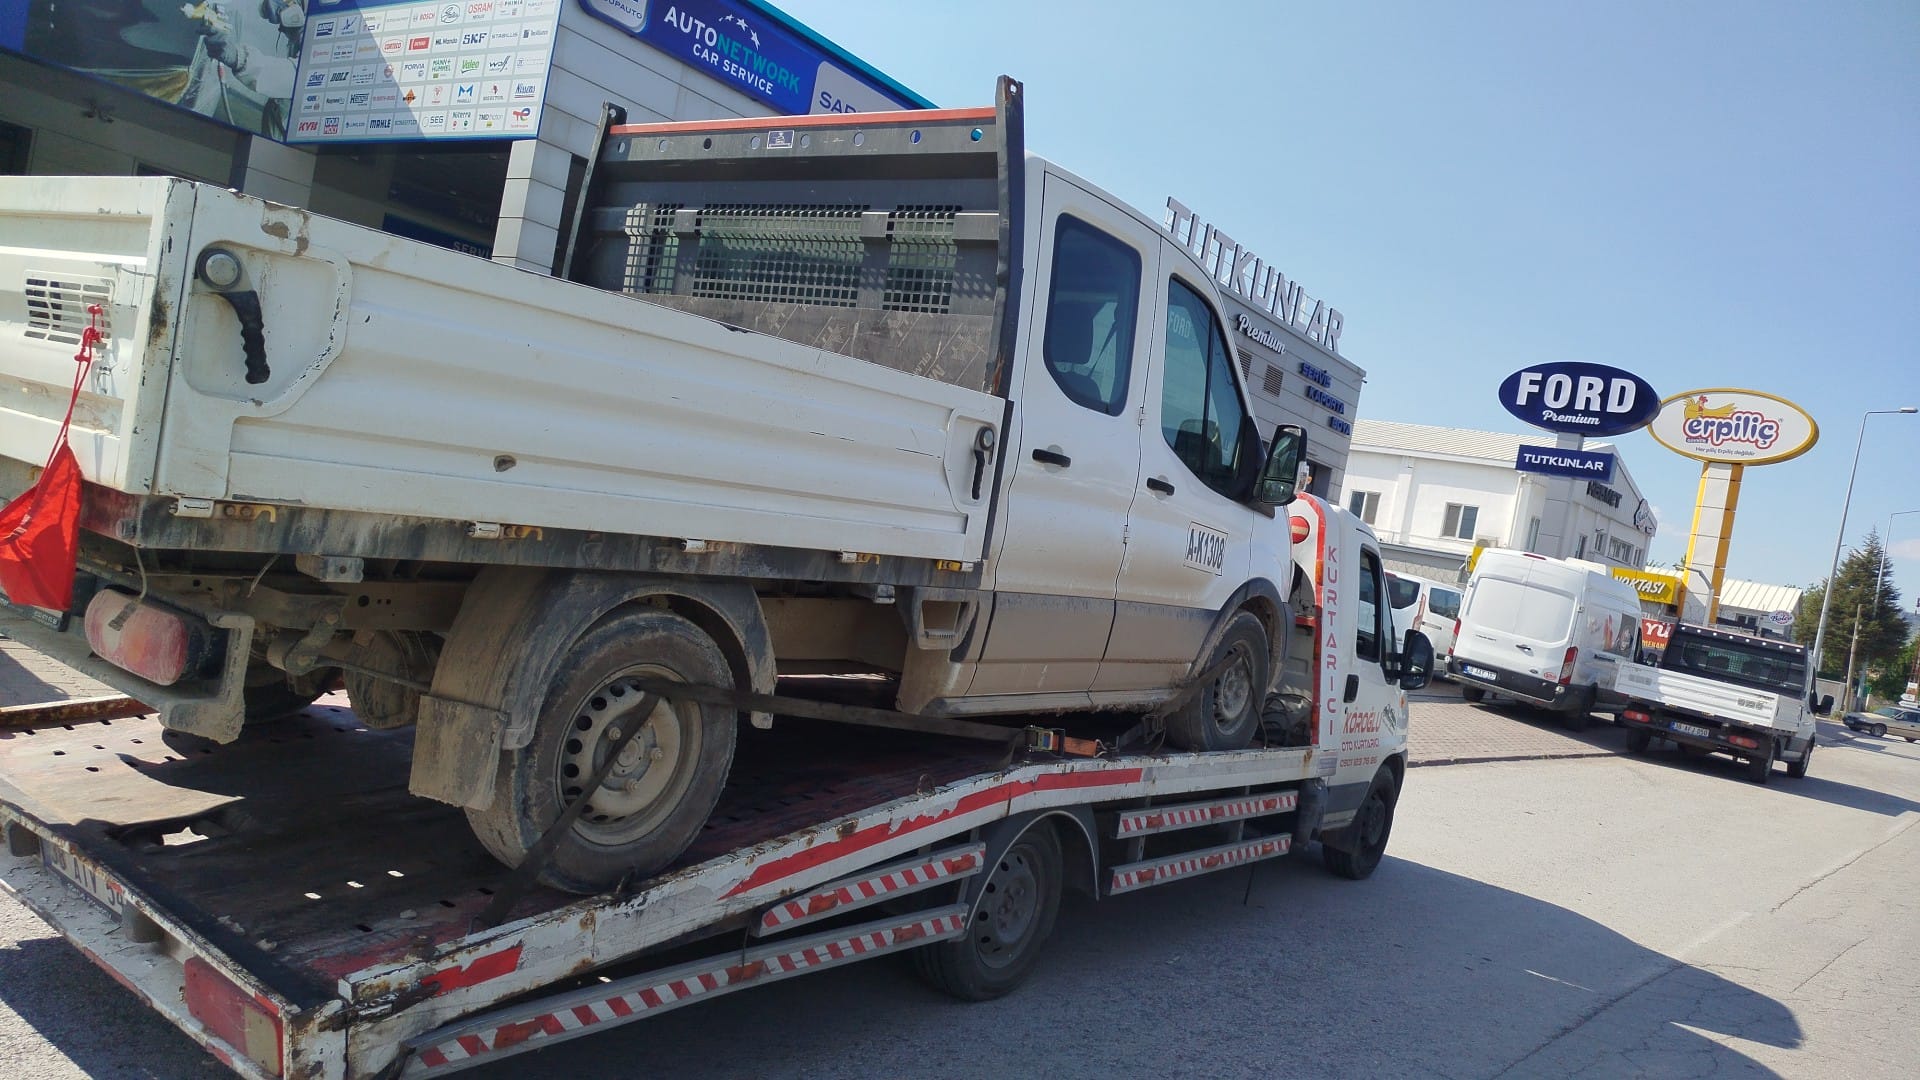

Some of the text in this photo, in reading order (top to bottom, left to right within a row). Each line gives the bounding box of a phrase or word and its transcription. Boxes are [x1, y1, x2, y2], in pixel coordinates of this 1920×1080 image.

[468, 3, 493, 14] OSRAM
[463, 33, 487, 45] SKF
[693, 43, 774, 95] CAR SERVICE
[369, 119, 392, 128] MAHLE
[1166, 196, 1345, 353] TUTKUNLAR
[1236, 313, 1287, 355] Premium
[1516, 372, 1637, 413] FORD
[1542, 410, 1601, 425] Premium
[1688, 416, 1774, 445] erpiliç
[1523, 453, 1604, 471] TUTKUNLAR
[1326, 545, 1338, 736] KURTARICI
